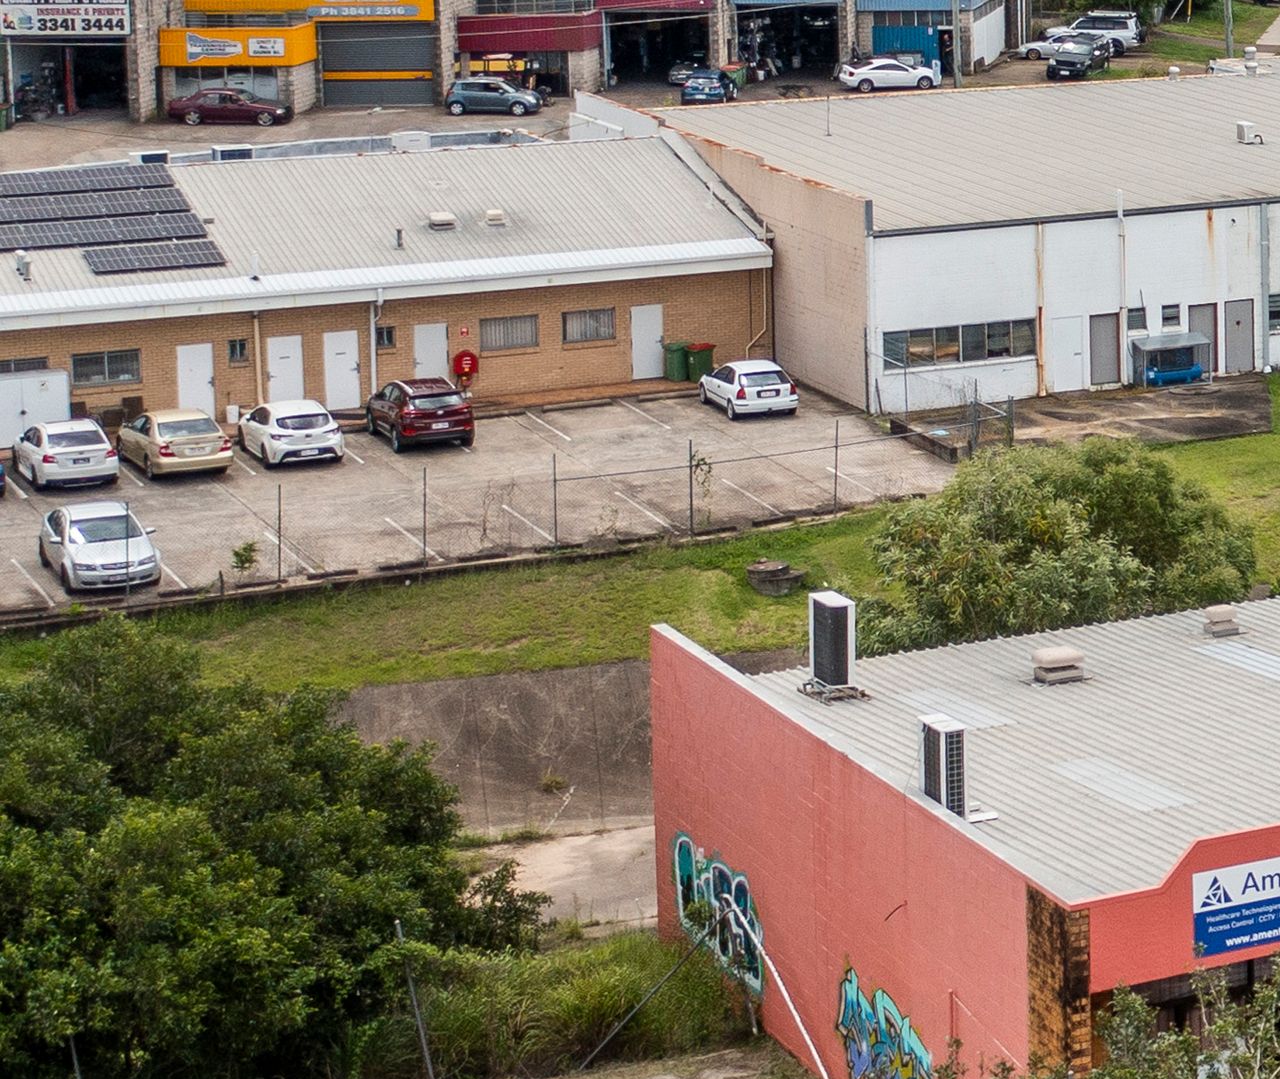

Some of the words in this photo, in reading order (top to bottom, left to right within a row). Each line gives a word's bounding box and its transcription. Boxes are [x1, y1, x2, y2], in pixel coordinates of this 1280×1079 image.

[37, 8, 81, 16] INSURANCE
[92, 8, 125, 16] PRIVATE
[320, 7, 338, 15] Ph
[37, 18, 76, 31] 3341
[81, 18, 125, 31] 3444
[1206, 910, 1241, 923] Healthcare
[1242, 903, 1280, 917] Technologies
[1208, 924, 1230, 933] Access
[1231, 917, 1254, 928] Control
[1259, 913, 1276, 923] CCTV
